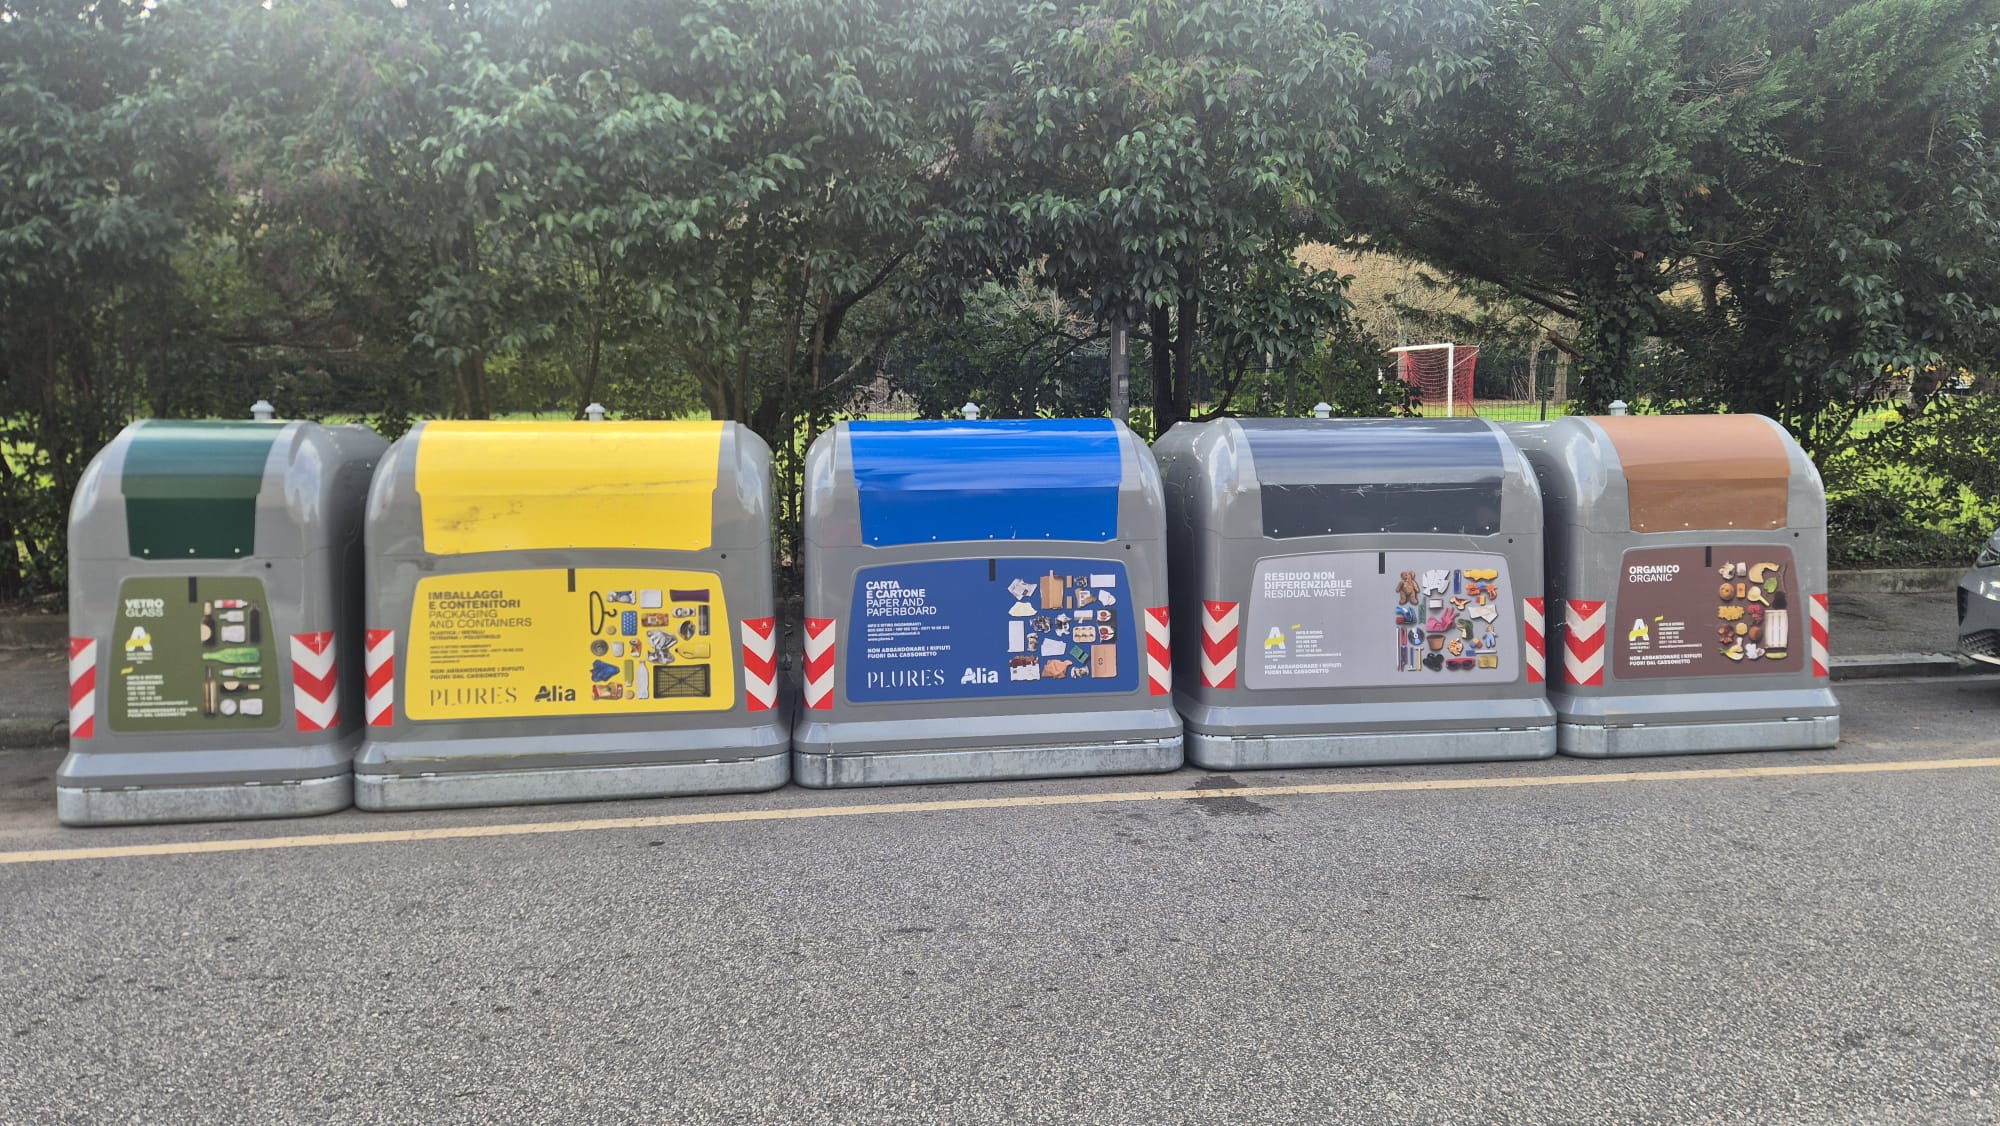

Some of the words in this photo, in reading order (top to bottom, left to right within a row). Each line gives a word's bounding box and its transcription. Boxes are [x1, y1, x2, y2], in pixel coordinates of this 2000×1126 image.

[1629, 564, 1680, 574] ORGANICO
[1264, 572, 1311, 580] RESIDUO
[1314, 571, 1335, 580] NON
[1629, 574, 1672, 582] ORGANIC
[866, 580, 900, 590] CARTA
[1264, 580, 1352, 590] DIFFERENZIABILE
[428, 590, 503, 600] IMBALLAGGI
[876, 589, 926, 598] CARTONE
[1264, 590, 1312, 598] RESIDUAL
[1313, 588, 1346, 598] WASTE
[125, 598, 164, 608] VETRO
[428, 602, 436, 610] E
[440, 600, 520, 610] CONTENITORI
[866, 598, 900, 608] PAPER
[902, 598, 924, 606] AND
[126, 608, 164, 617] GLASS
[429, 609, 498, 619] PACKAGING
[866, 606, 937, 616] PAPERBOARD
[429, 620, 454, 628] AND
[457, 618, 532, 628] CONTAINERS
[868, 669, 945, 688] PLURES
[961, 668, 998, 684] Alia
[430, 686, 518, 706] PLURES
[534, 685, 576, 702] Alia
